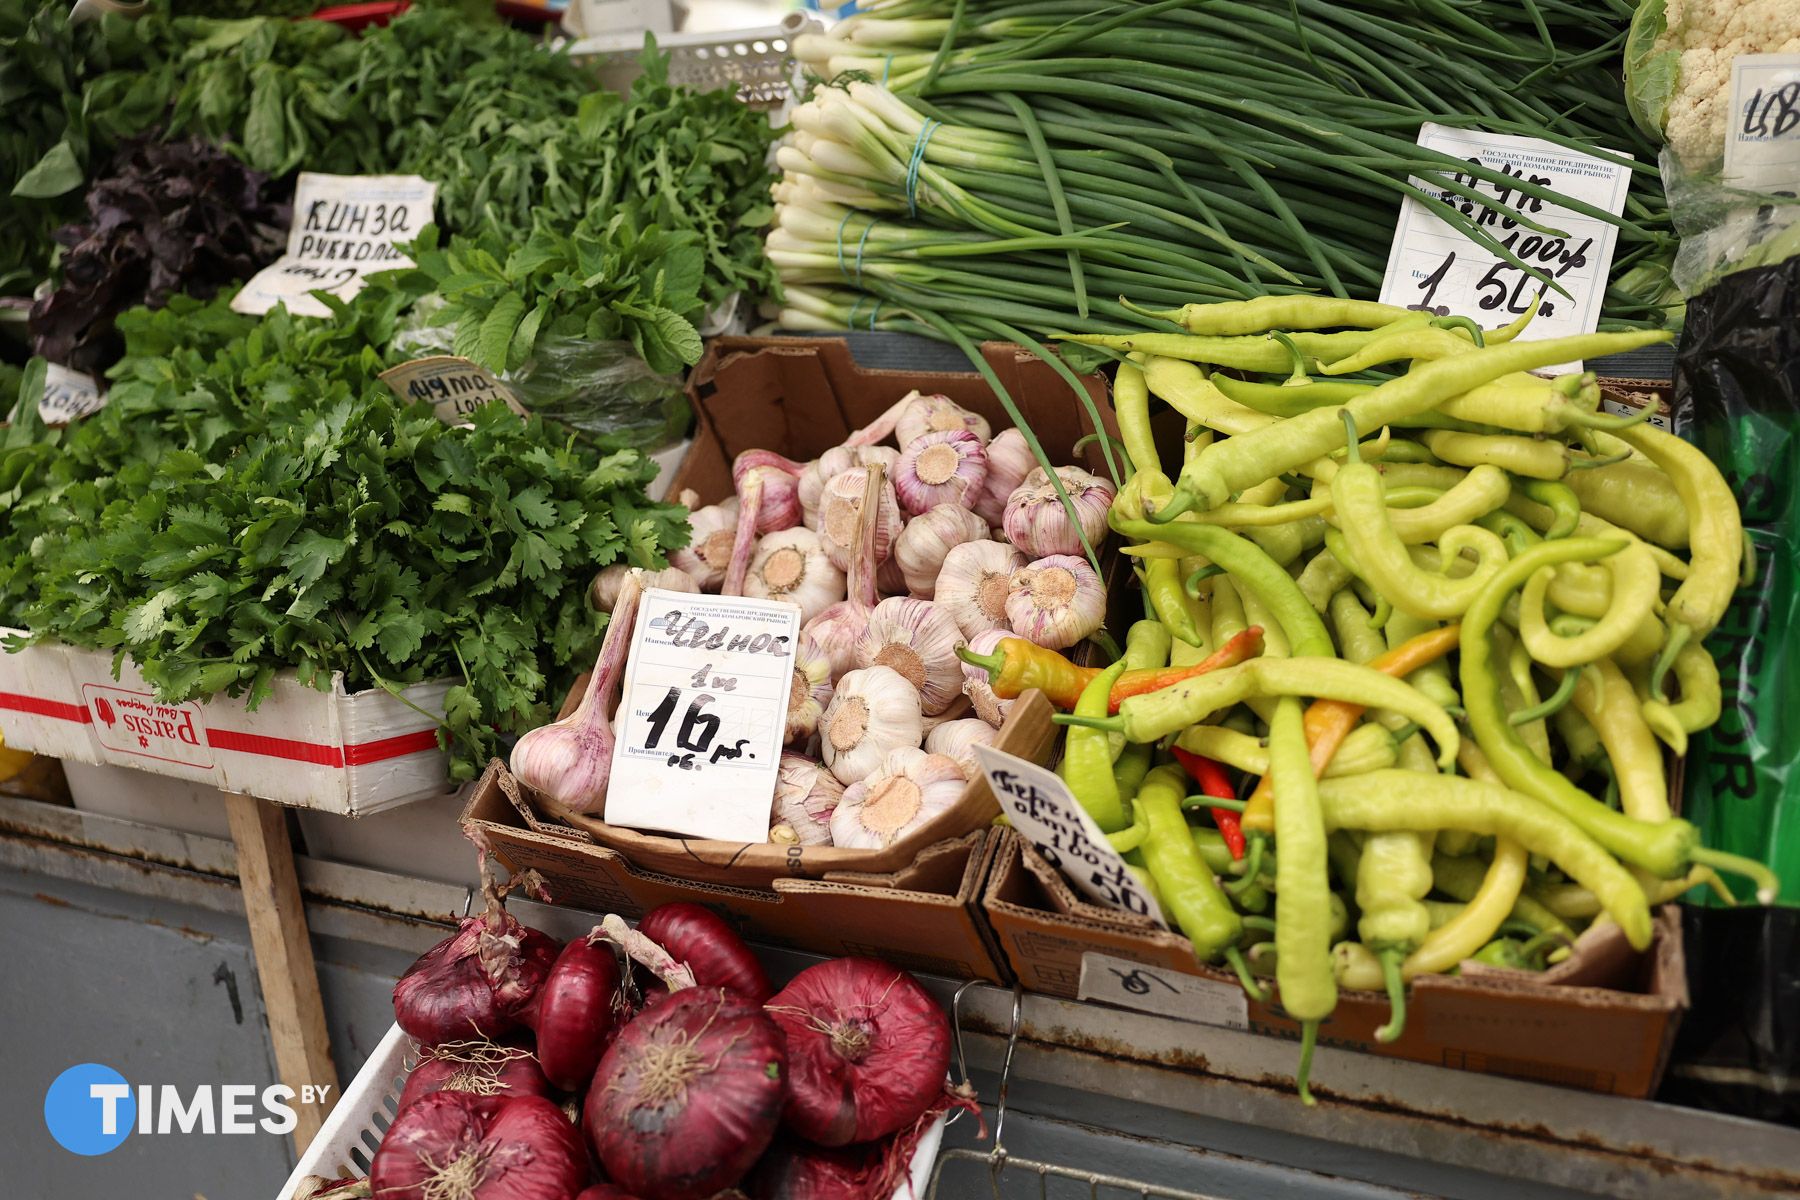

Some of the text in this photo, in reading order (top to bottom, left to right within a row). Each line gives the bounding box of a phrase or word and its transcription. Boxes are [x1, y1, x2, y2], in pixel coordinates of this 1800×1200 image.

[1482, 149, 1614, 173] ГОСУДАРСТВЕННОЕ ПРЕДПРИЯТИЕ
[1523, 161, 1581, 175] КОМАРОВСКИЙ
[123, 710, 201, 746] Parsis
[644, 686, 721, 753] 16
